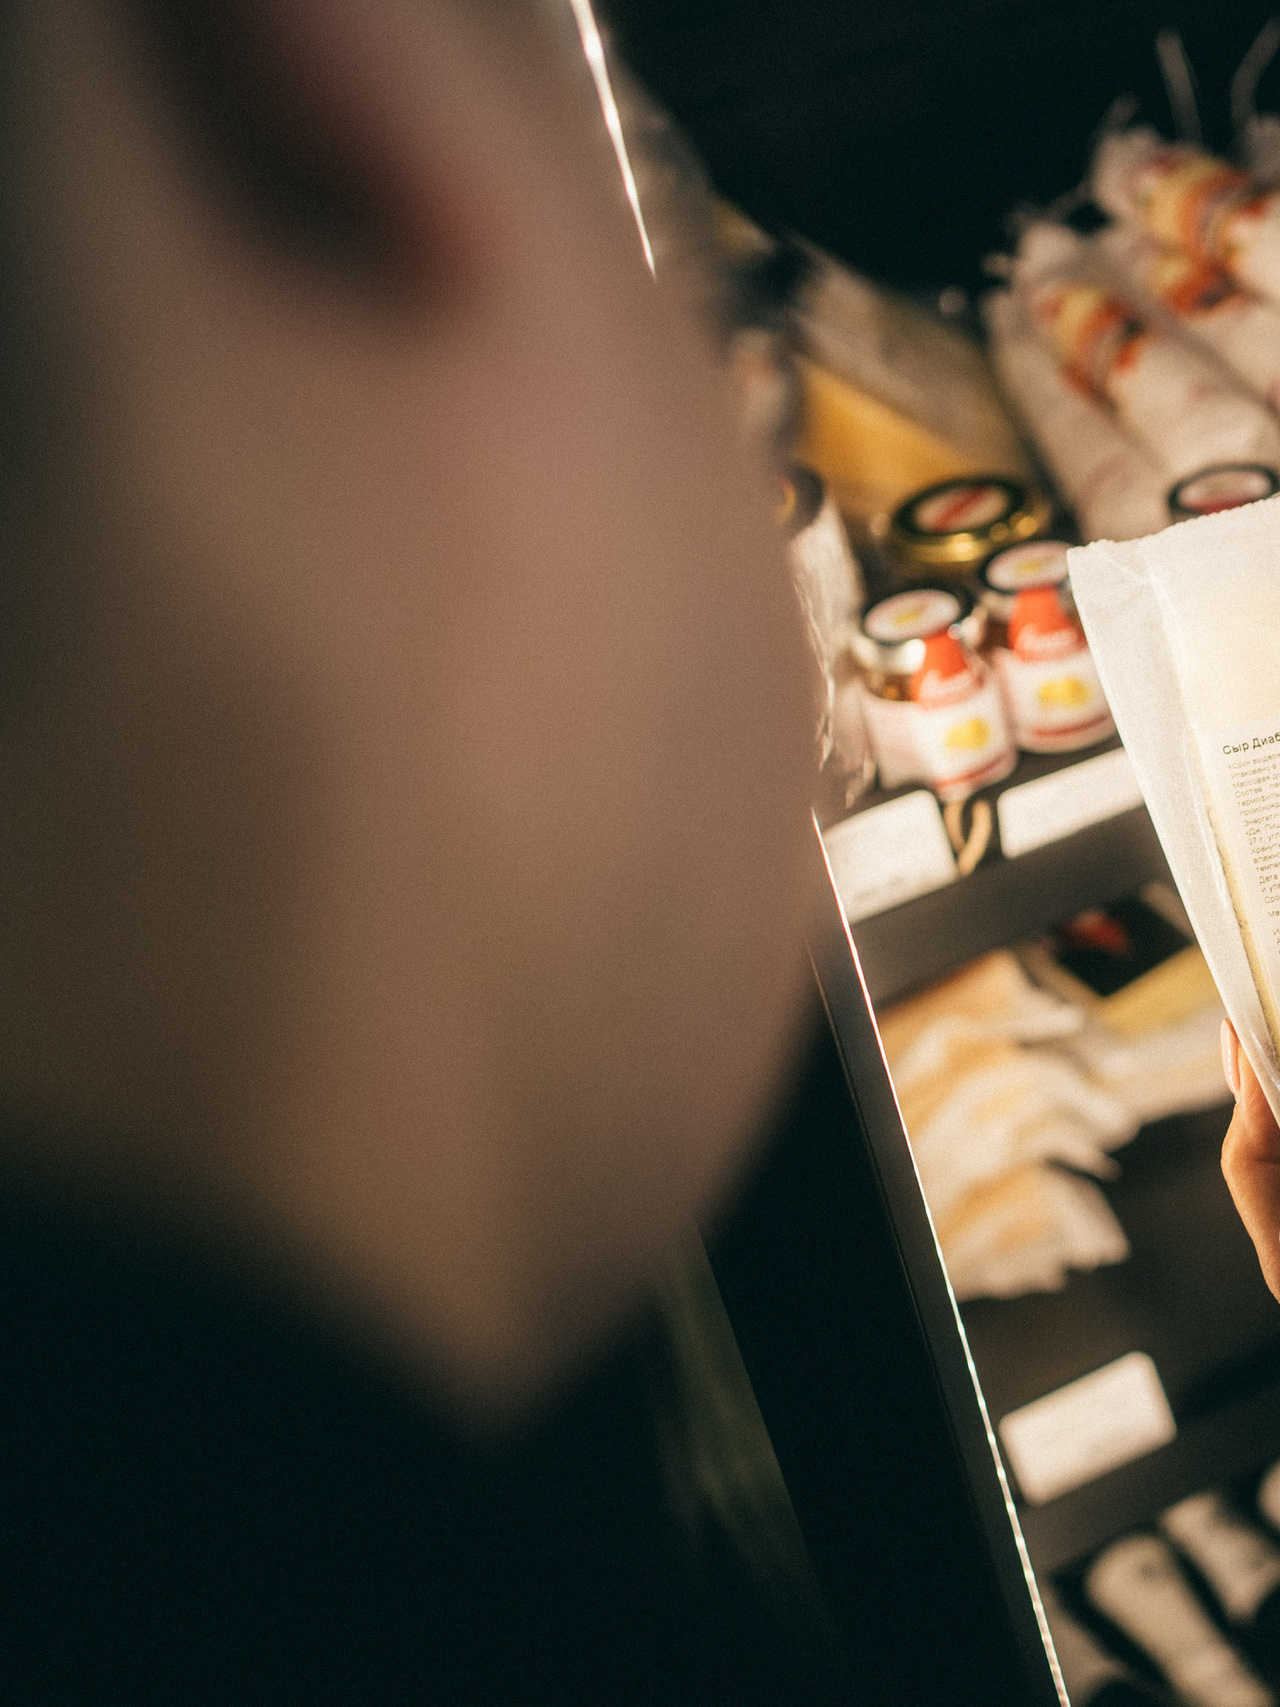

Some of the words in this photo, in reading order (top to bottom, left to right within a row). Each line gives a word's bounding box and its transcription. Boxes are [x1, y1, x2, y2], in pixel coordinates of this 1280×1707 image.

[1222, 741, 1250, 756] Сыр
[1230, 765, 1271, 780] Упаковано
[1232, 775, 1271, 790] Массовая
[1248, 837, 1257, 845] 27
[1258, 874, 1278, 885] Дата
